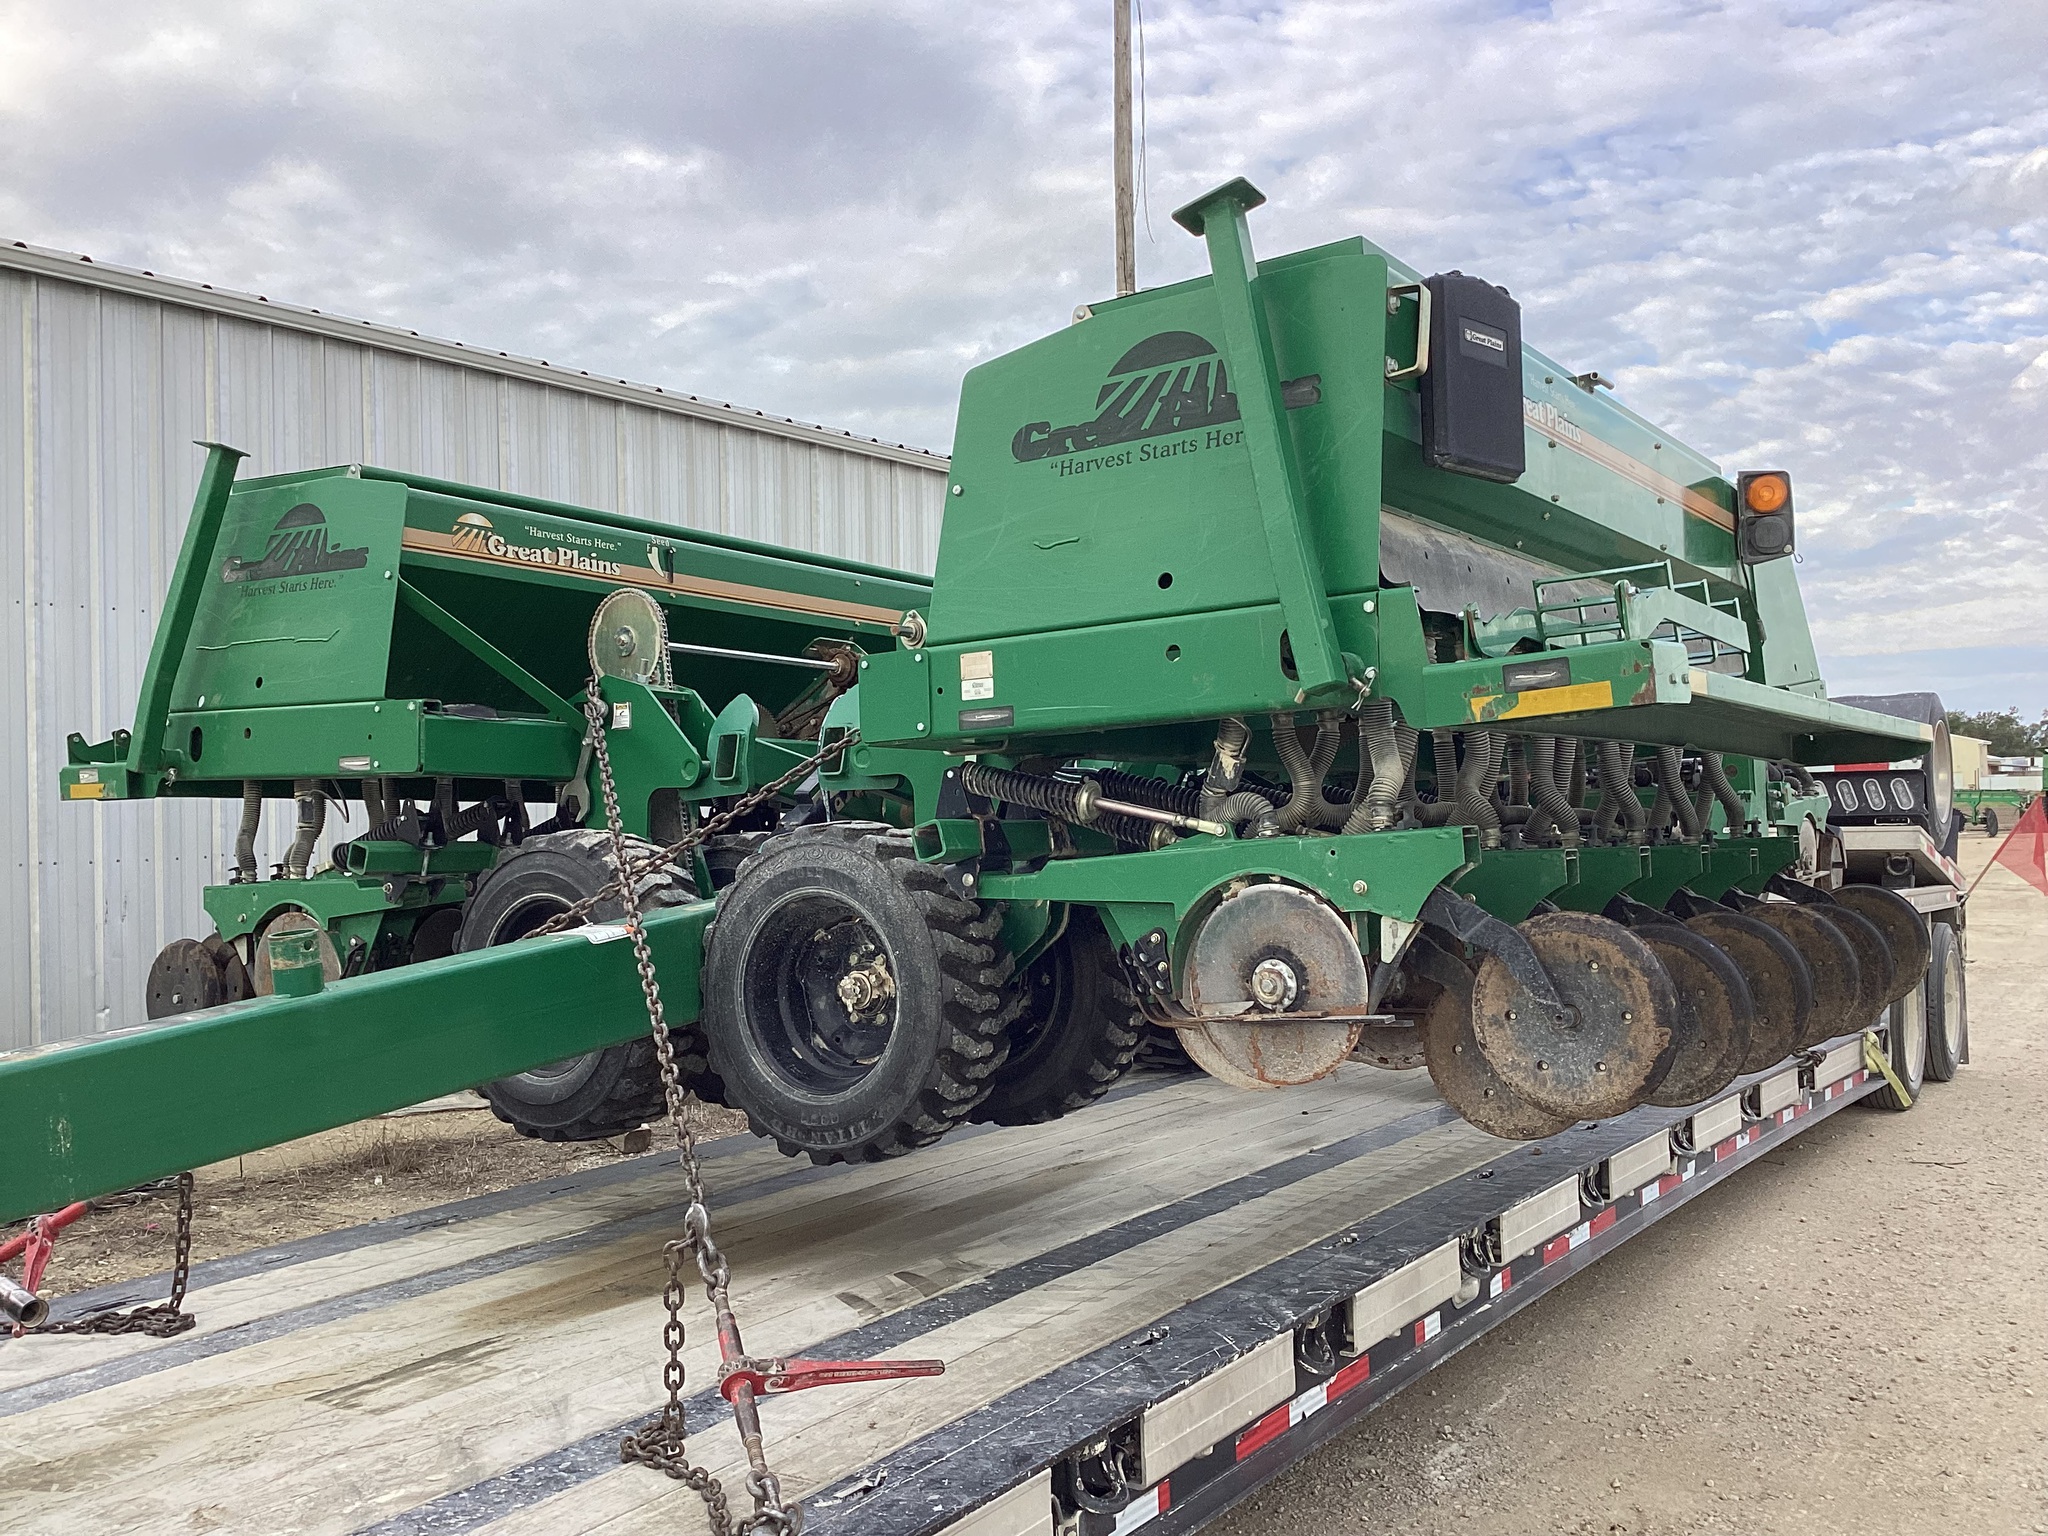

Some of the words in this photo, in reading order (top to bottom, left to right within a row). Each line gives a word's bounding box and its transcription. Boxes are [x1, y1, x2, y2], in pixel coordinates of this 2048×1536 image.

[1472, 333, 1487, 344] Great
[1523, 396, 1545, 424] reat
[1545, 402, 1581, 444] Plains
[1050, 450, 1133, 477] “Harvest
[1139, 438, 1198, 462] Starts
[1205, 428, 1245, 450] Her
[524, 525, 565, 542] “Harvest
[566, 533, 592, 547] Starts
[651, 536, 670, 547] Seed
[486, 534, 552, 565] Great
[555, 546, 621, 577] Plains
[278, 580, 308, 594] Starts
